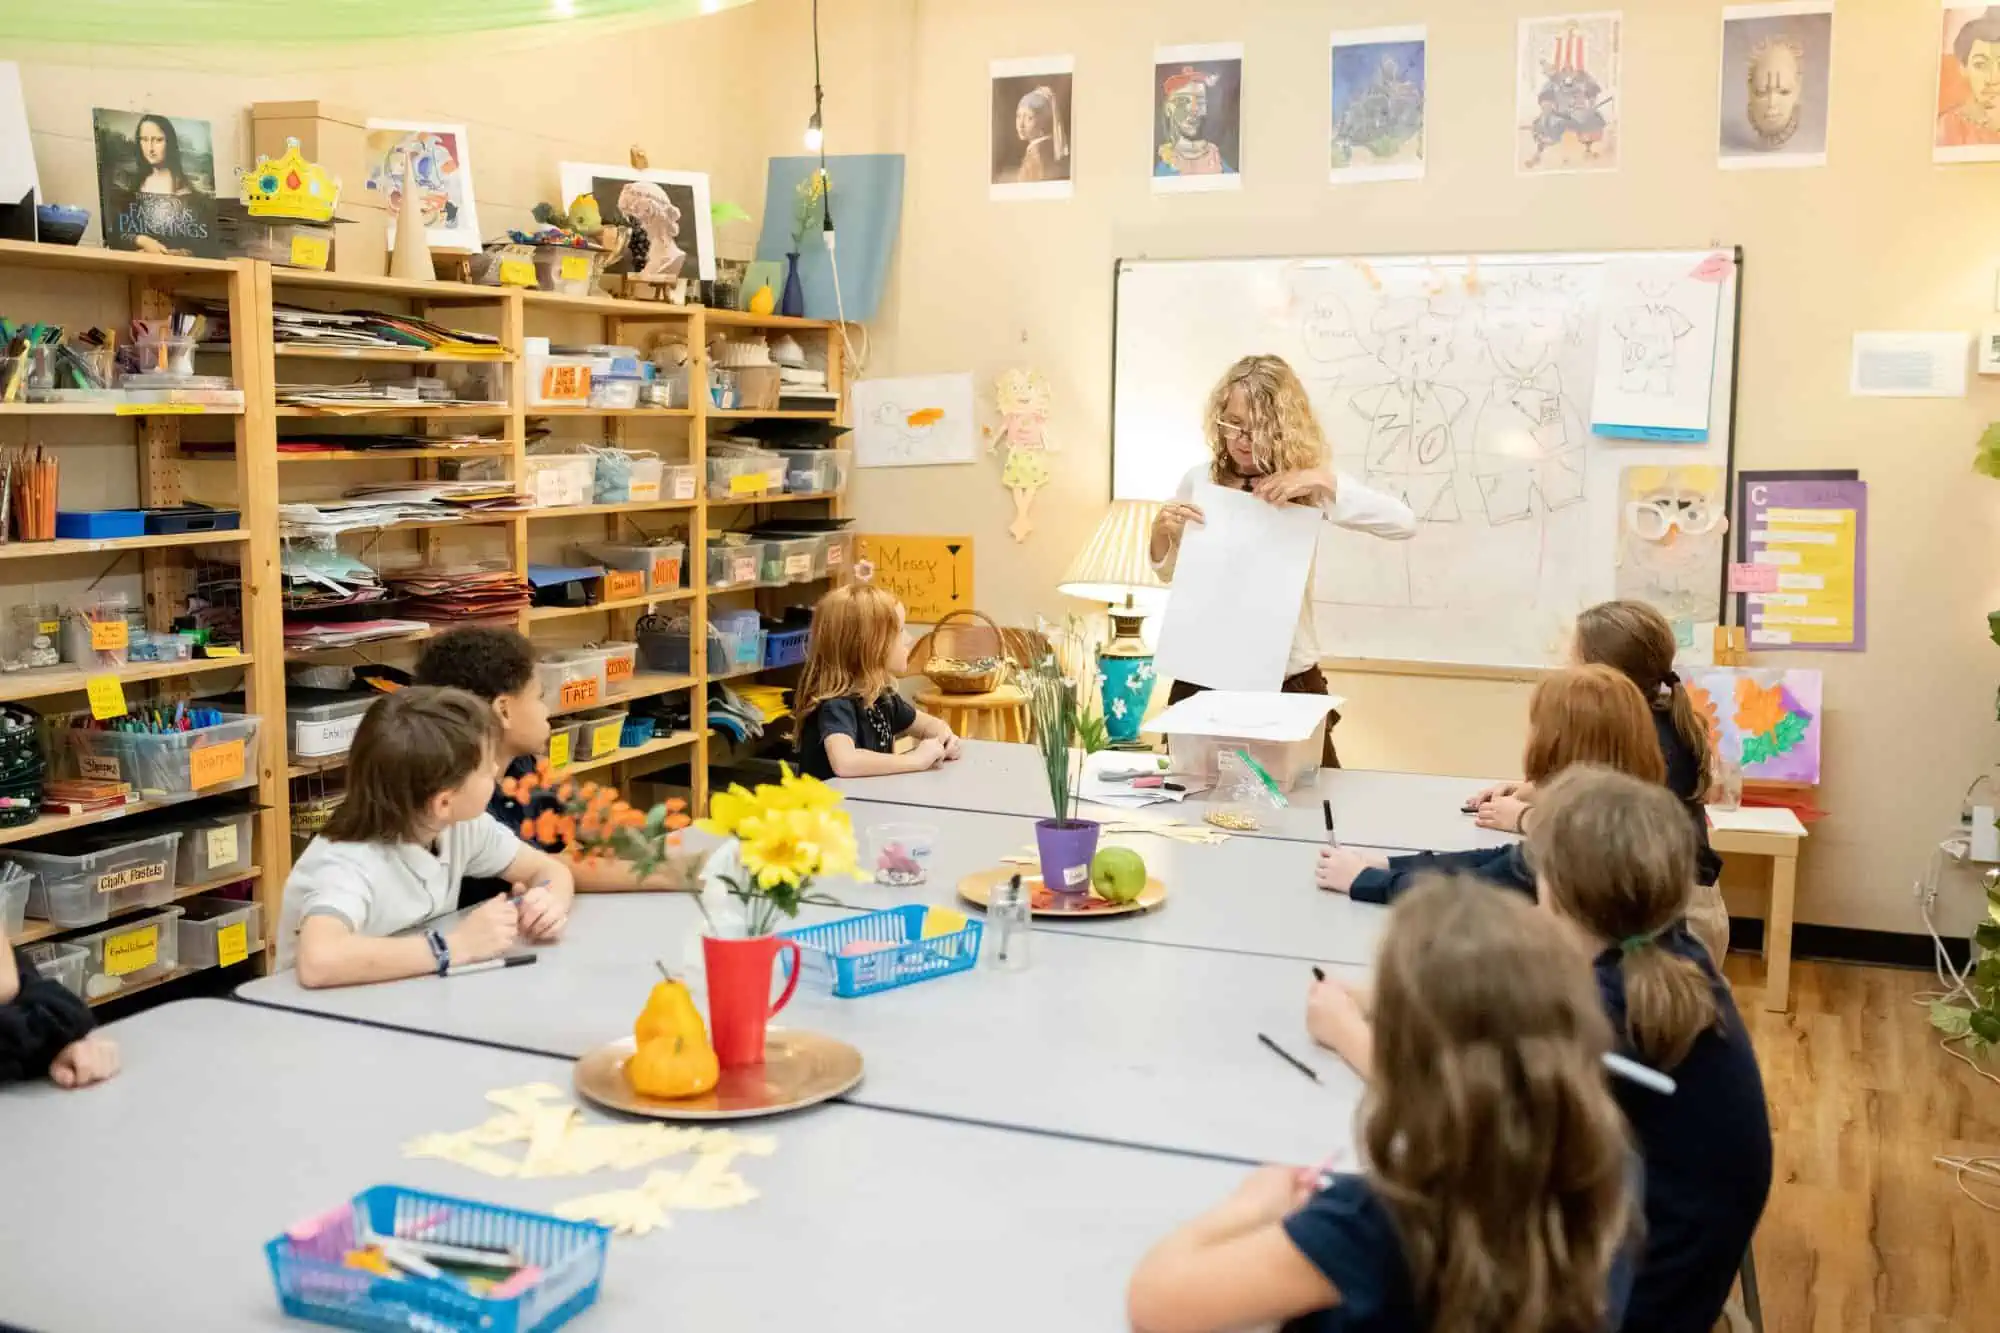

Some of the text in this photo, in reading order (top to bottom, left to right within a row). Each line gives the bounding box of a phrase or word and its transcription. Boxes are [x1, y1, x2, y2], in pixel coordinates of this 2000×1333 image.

[129, 202, 194, 222] FAMUS
[878, 544, 938, 584] Messy
[100, 863, 163, 890] Chalk Pastels
